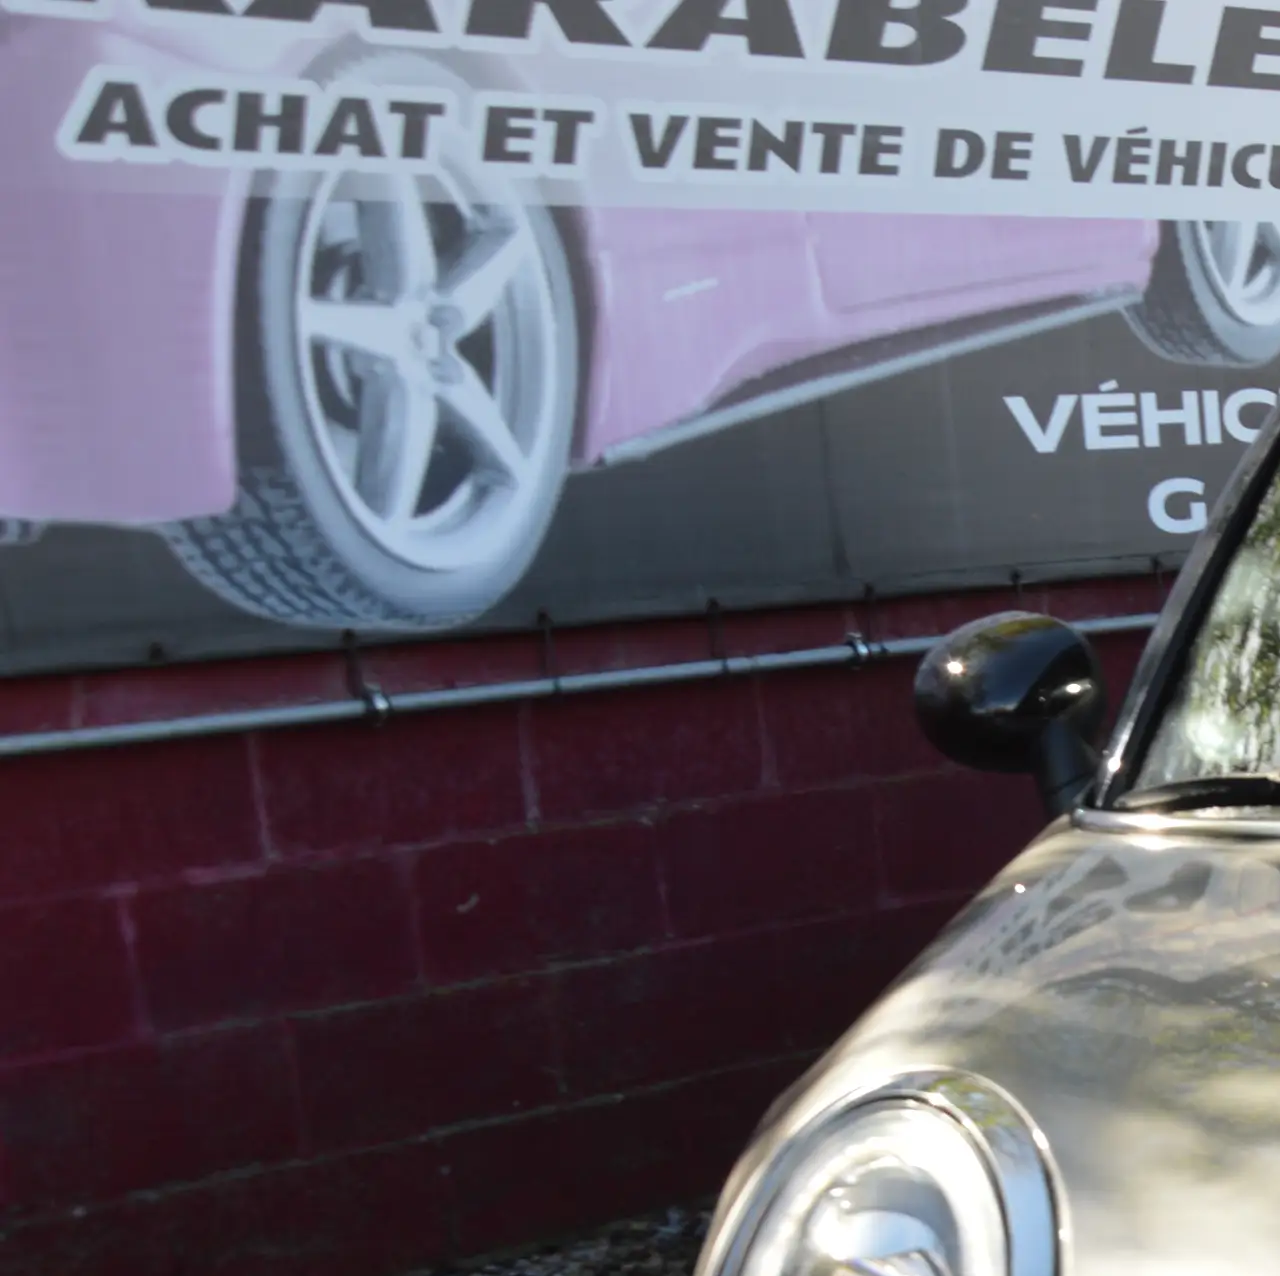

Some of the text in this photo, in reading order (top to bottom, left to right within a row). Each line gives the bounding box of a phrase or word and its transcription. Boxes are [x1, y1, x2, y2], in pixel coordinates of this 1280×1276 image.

[76, 81, 446, 161] ACHAT
[481, 106, 595, 165] ET
[629, 113, 904, 176] VENTE
[934, 127, 1034, 181] DE
